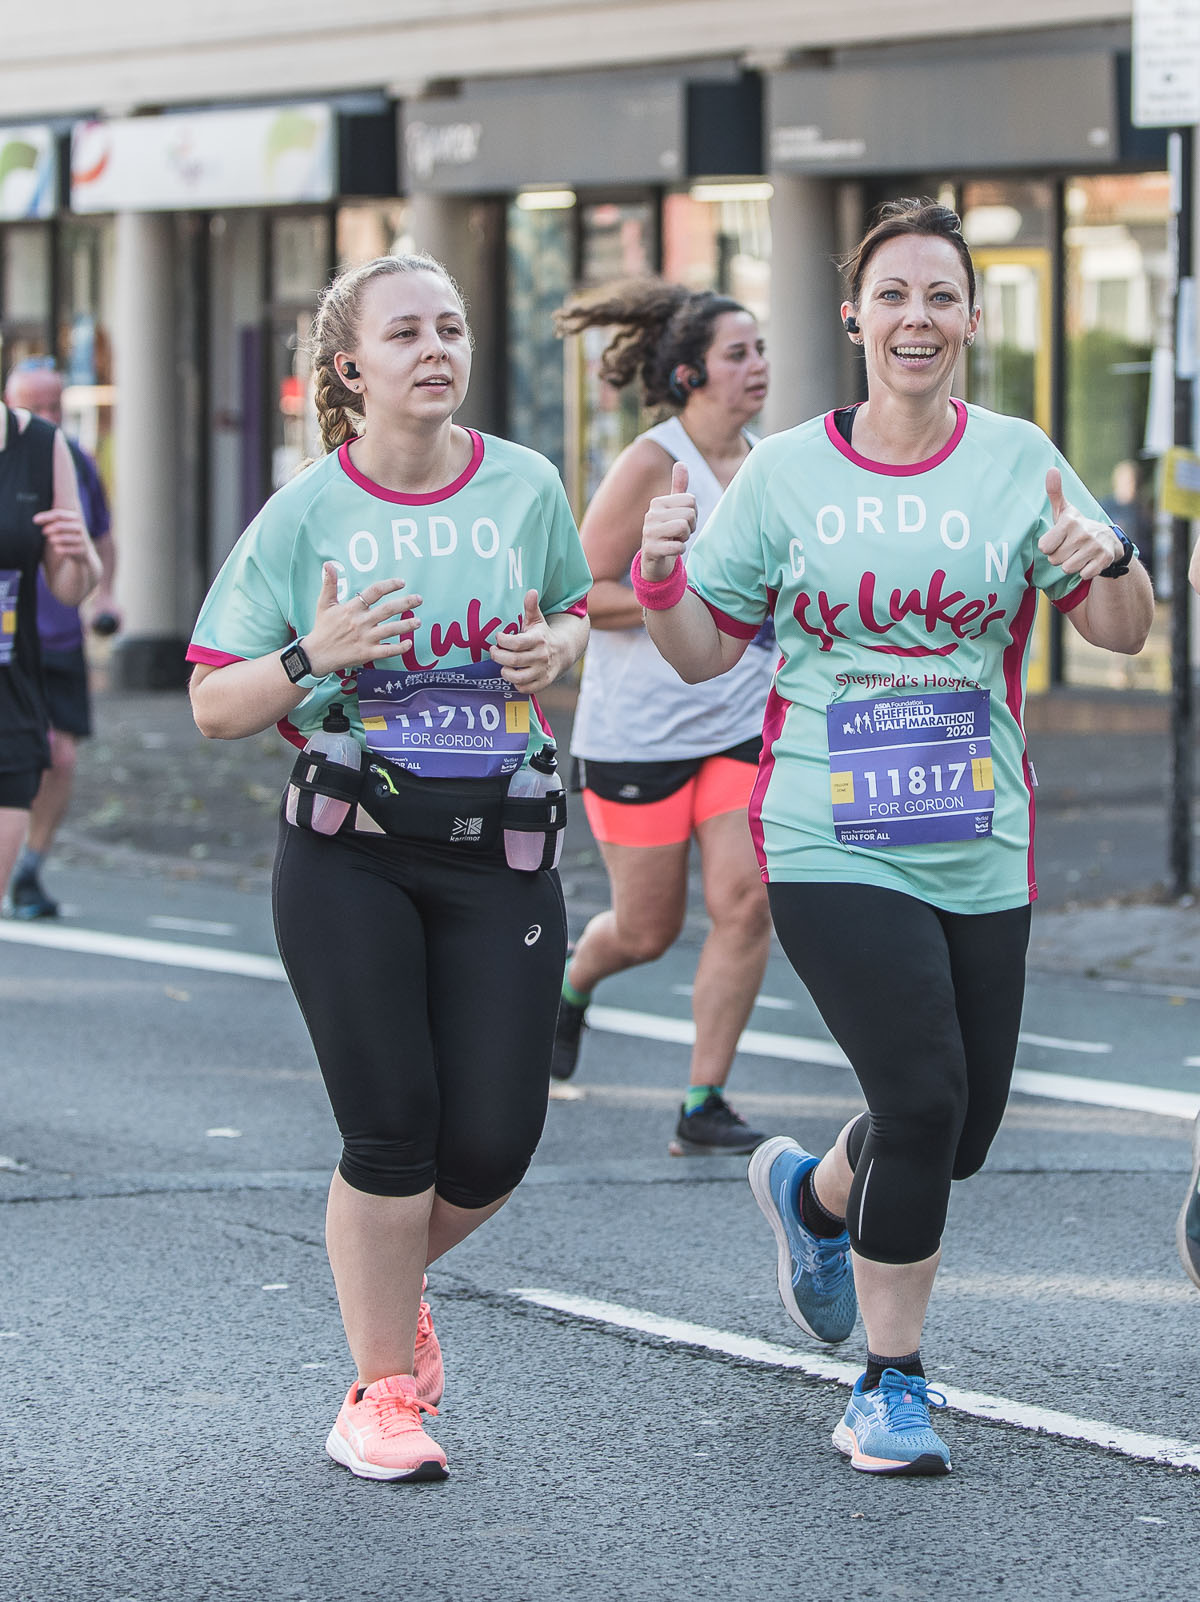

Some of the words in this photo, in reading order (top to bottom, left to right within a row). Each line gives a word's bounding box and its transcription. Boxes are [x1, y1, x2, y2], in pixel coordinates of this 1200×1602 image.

[787, 495, 1009, 583] GORDON
[321, 516, 523, 601] GORDON
[858, 569, 1006, 640] Luke's
[835, 673, 919, 688] Sheffield's
[396, 703, 500, 731] 11710
[875, 705, 932, 720] SHEFFIELD
[876, 718, 906, 732] HALF
[908, 713, 973, 728] MARATHON
[946, 724, 974, 738] 2020
[402, 733, 431, 745] FOR
[434, 733, 494, 748] GORDON
[968, 743, 977, 755] S
[407, 762, 421, 770] ALL
[864, 762, 967, 798] 11817
[869, 802, 901, 816] FOR
[904, 796, 964, 814] GORDON
[860, 833, 875, 841] FOR
[877, 832, 890, 840] ALL
